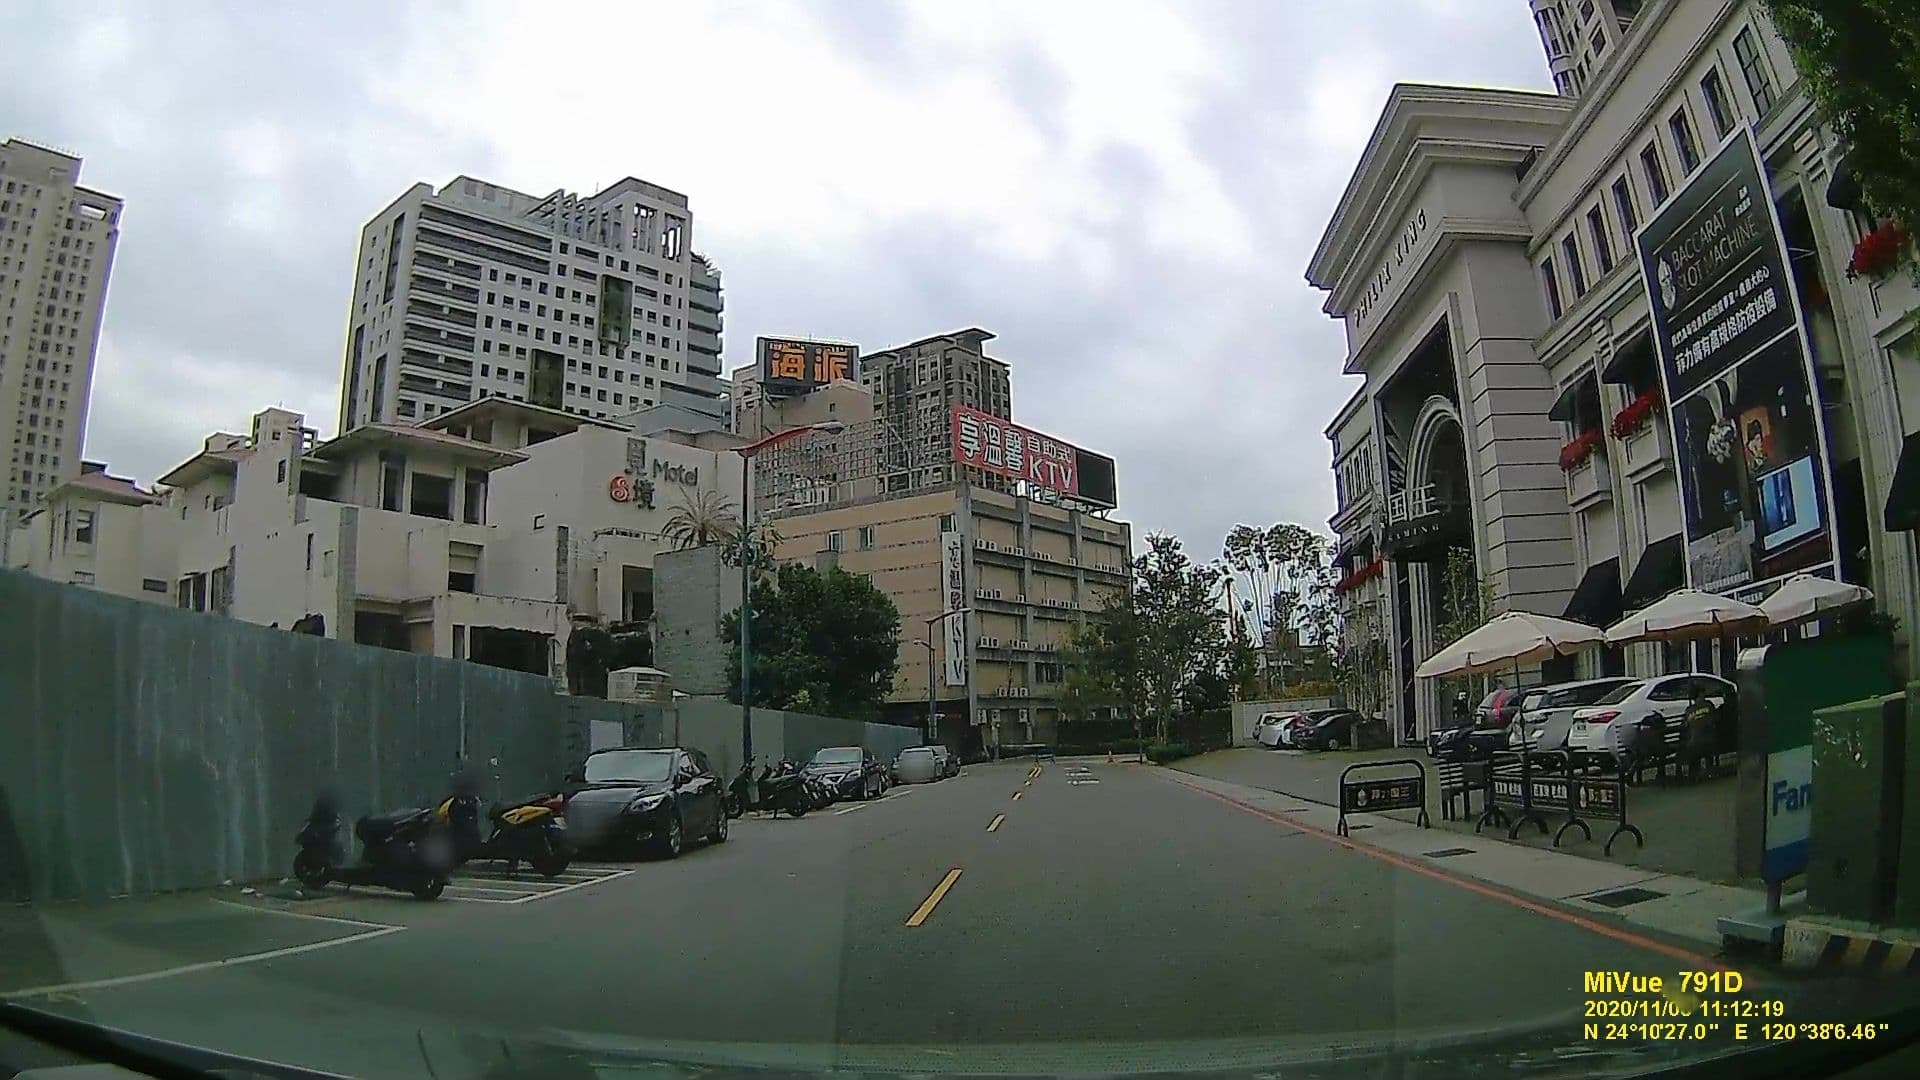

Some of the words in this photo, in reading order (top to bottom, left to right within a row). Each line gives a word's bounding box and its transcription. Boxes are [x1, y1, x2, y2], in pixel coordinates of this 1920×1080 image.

[1393, 207, 1427, 267] KING
[1671, 205, 1727, 272] BACCARAT
[1677, 263, 1703, 293] SLOT
[1703, 213, 1759, 275] MACHINE
[768, 342, 848, 382] 海派
[1027, 435, 1072, 465] 自助式
[652, 458, 699, 487] Motel
[1029, 455, 1073, 489] KTV
